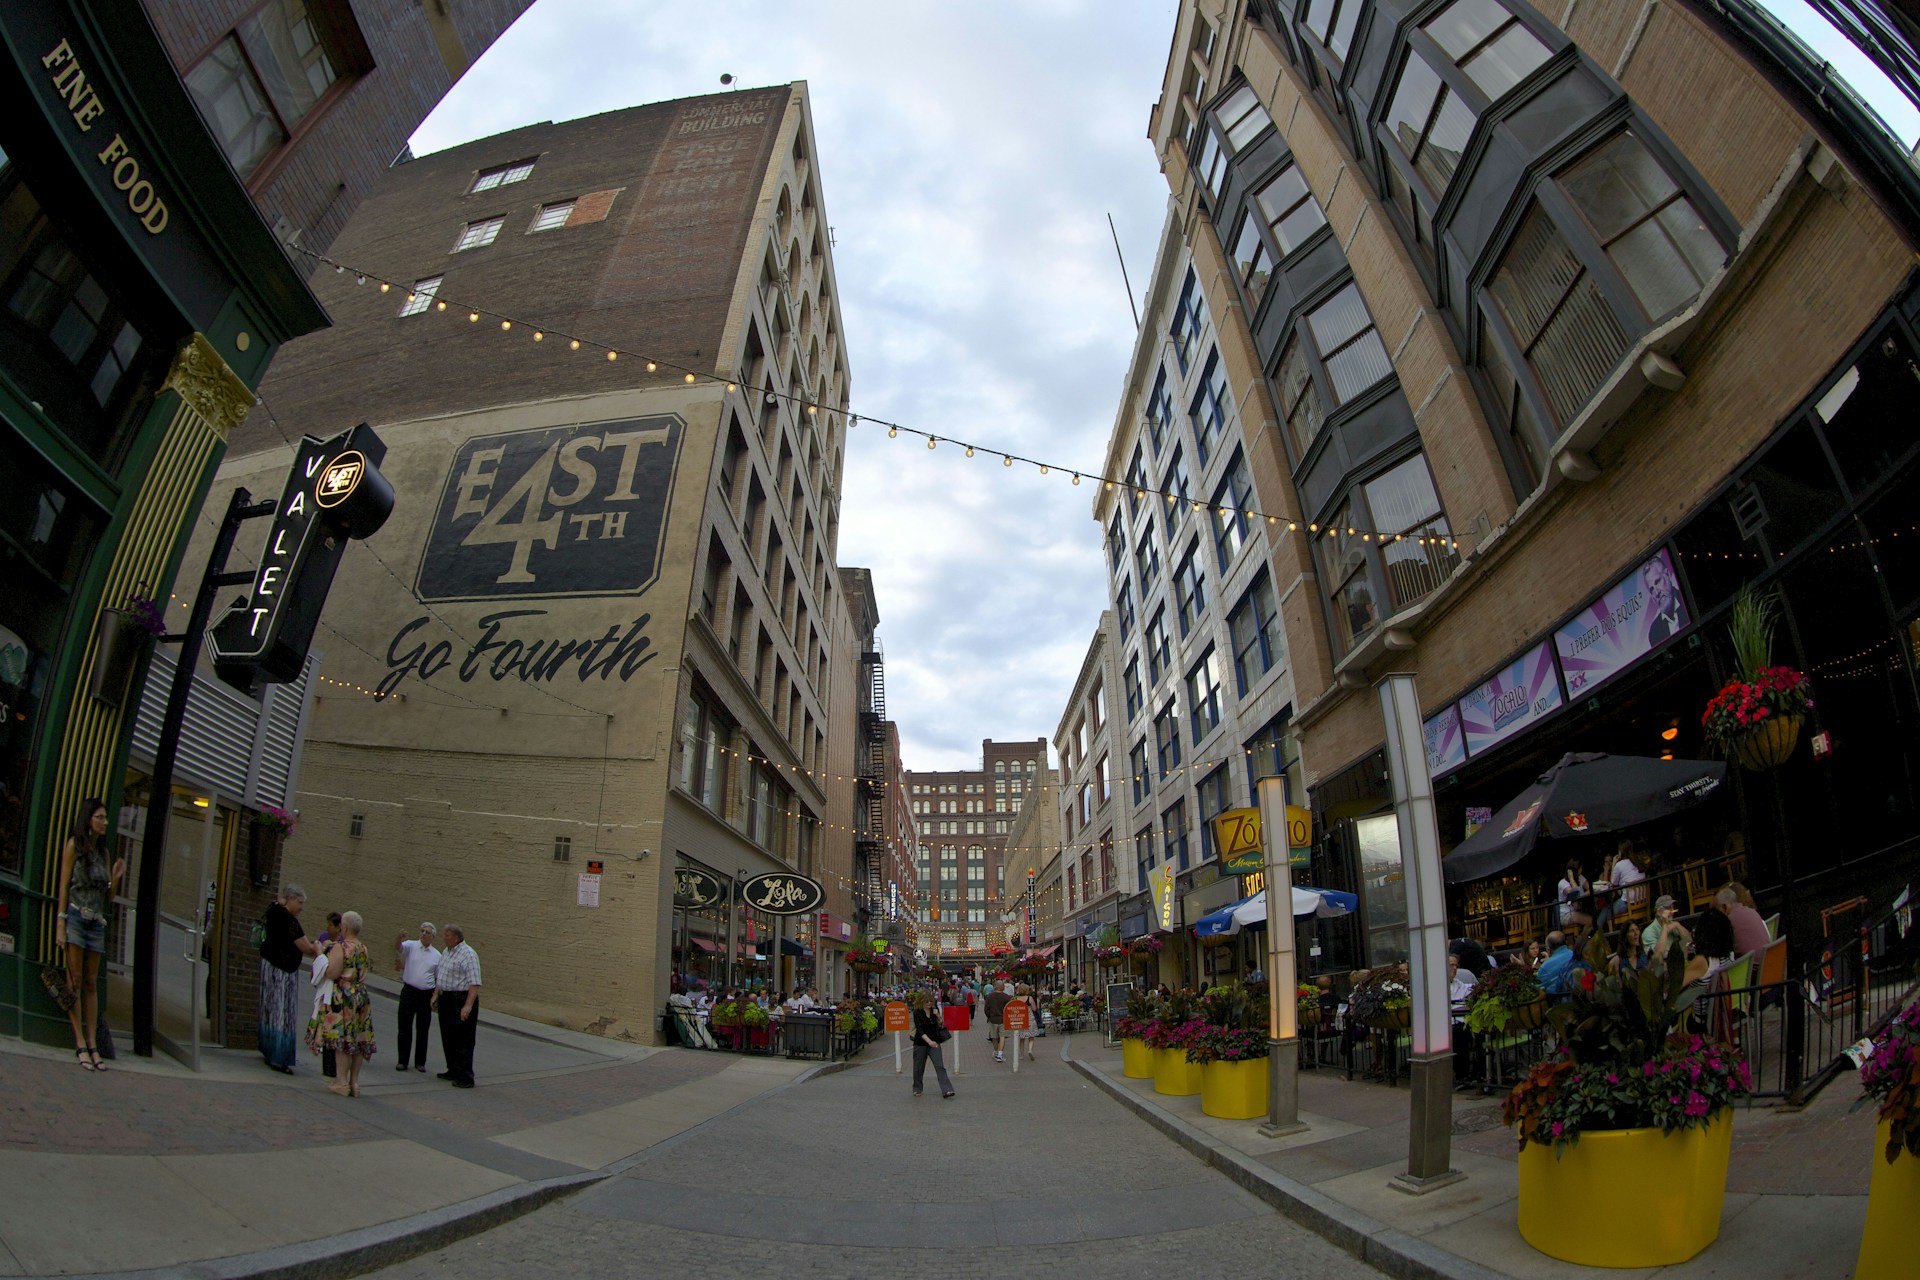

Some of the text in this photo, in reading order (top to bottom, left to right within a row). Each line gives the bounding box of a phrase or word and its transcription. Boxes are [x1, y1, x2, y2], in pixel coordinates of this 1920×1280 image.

[42, 37, 169, 234] FINE FOOD
[679, 112, 765, 134] BUILDING
[251, 454, 325, 636] VALET
[373, 609, 658, 703] Go Fourth
[1574, 625, 1601, 654] PREFER
[1600, 613, 1617, 635] DOS
[1668, 786, 1685, 799] STAY
[756, 878, 808, 908] Lola
[1162, 865, 1174, 927] SAIGON
